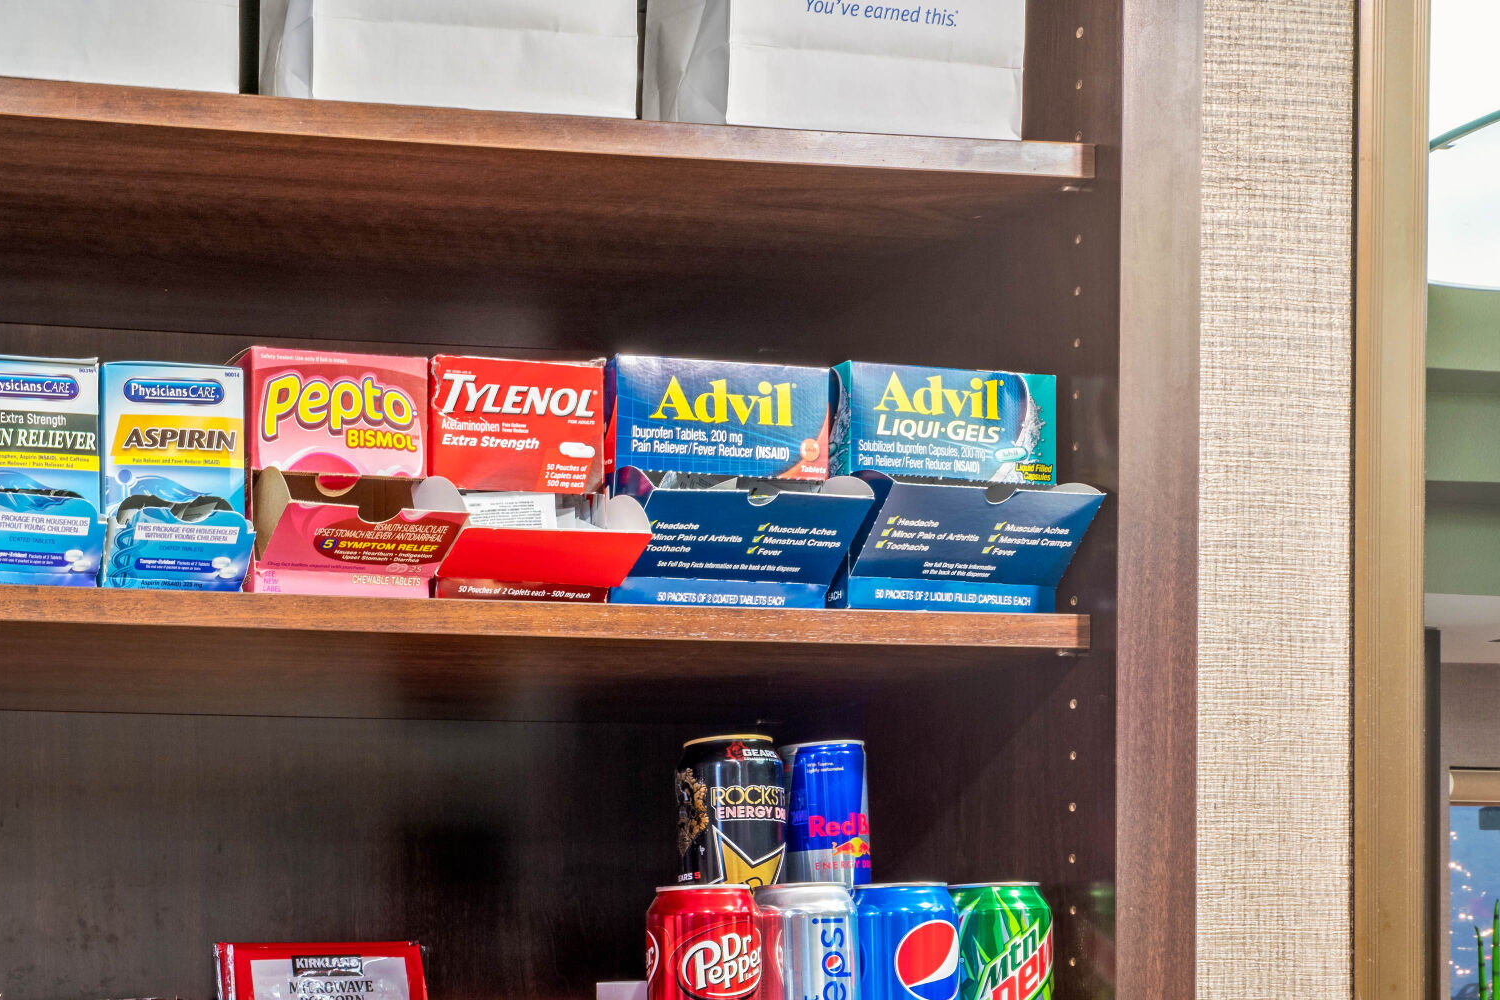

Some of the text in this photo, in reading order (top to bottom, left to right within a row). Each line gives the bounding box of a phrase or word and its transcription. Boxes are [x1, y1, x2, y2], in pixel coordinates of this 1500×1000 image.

[864, 5, 921, 23] earned
[925, 9, 959, 27] this.
[442, 372, 595, 418] TYLENOL
[649, 375, 794, 426] Advil
[873, 370, 1002, 420] Advil
[263, 374, 414, 440] Pepto
[0, 412, 67, 428] Extra Strength
[442, 418, 500, 434] Acetaminophen
[16, 428, 96, 450] RELIEVER
[122, 426, 236, 452] ASPIRIN
[347, 430, 417, 452] BISMOL
[442, 434, 540, 451] Extra Strength
[632, 424, 743, 446] Ibuprofen Tablets, 200 mg
[632, 438, 790, 462] Pain Reducer (NSAID)
[550, 472, 572, 480] Caplets
[556, 464, 579, 472] Pouches
[800, 464, 826, 474] Tablets
[656, 522, 838, 536] Headache Muscular Aches
[322, 539, 438, 552] 5 SYMPTOM RELIEF
[352, 574, 421, 586] CHEWABLE TABLETS
[742, 748, 778, 758] GEARS
[716, 806, 773, 819] ENERGY
[808, 814, 855, 838] Red
[720, 932, 752, 962] Dr
[295, 958, 360, 968] KIRKLAND
[682, 940, 761, 991] Pepper
[980, 928, 1037, 1000] Mtn
